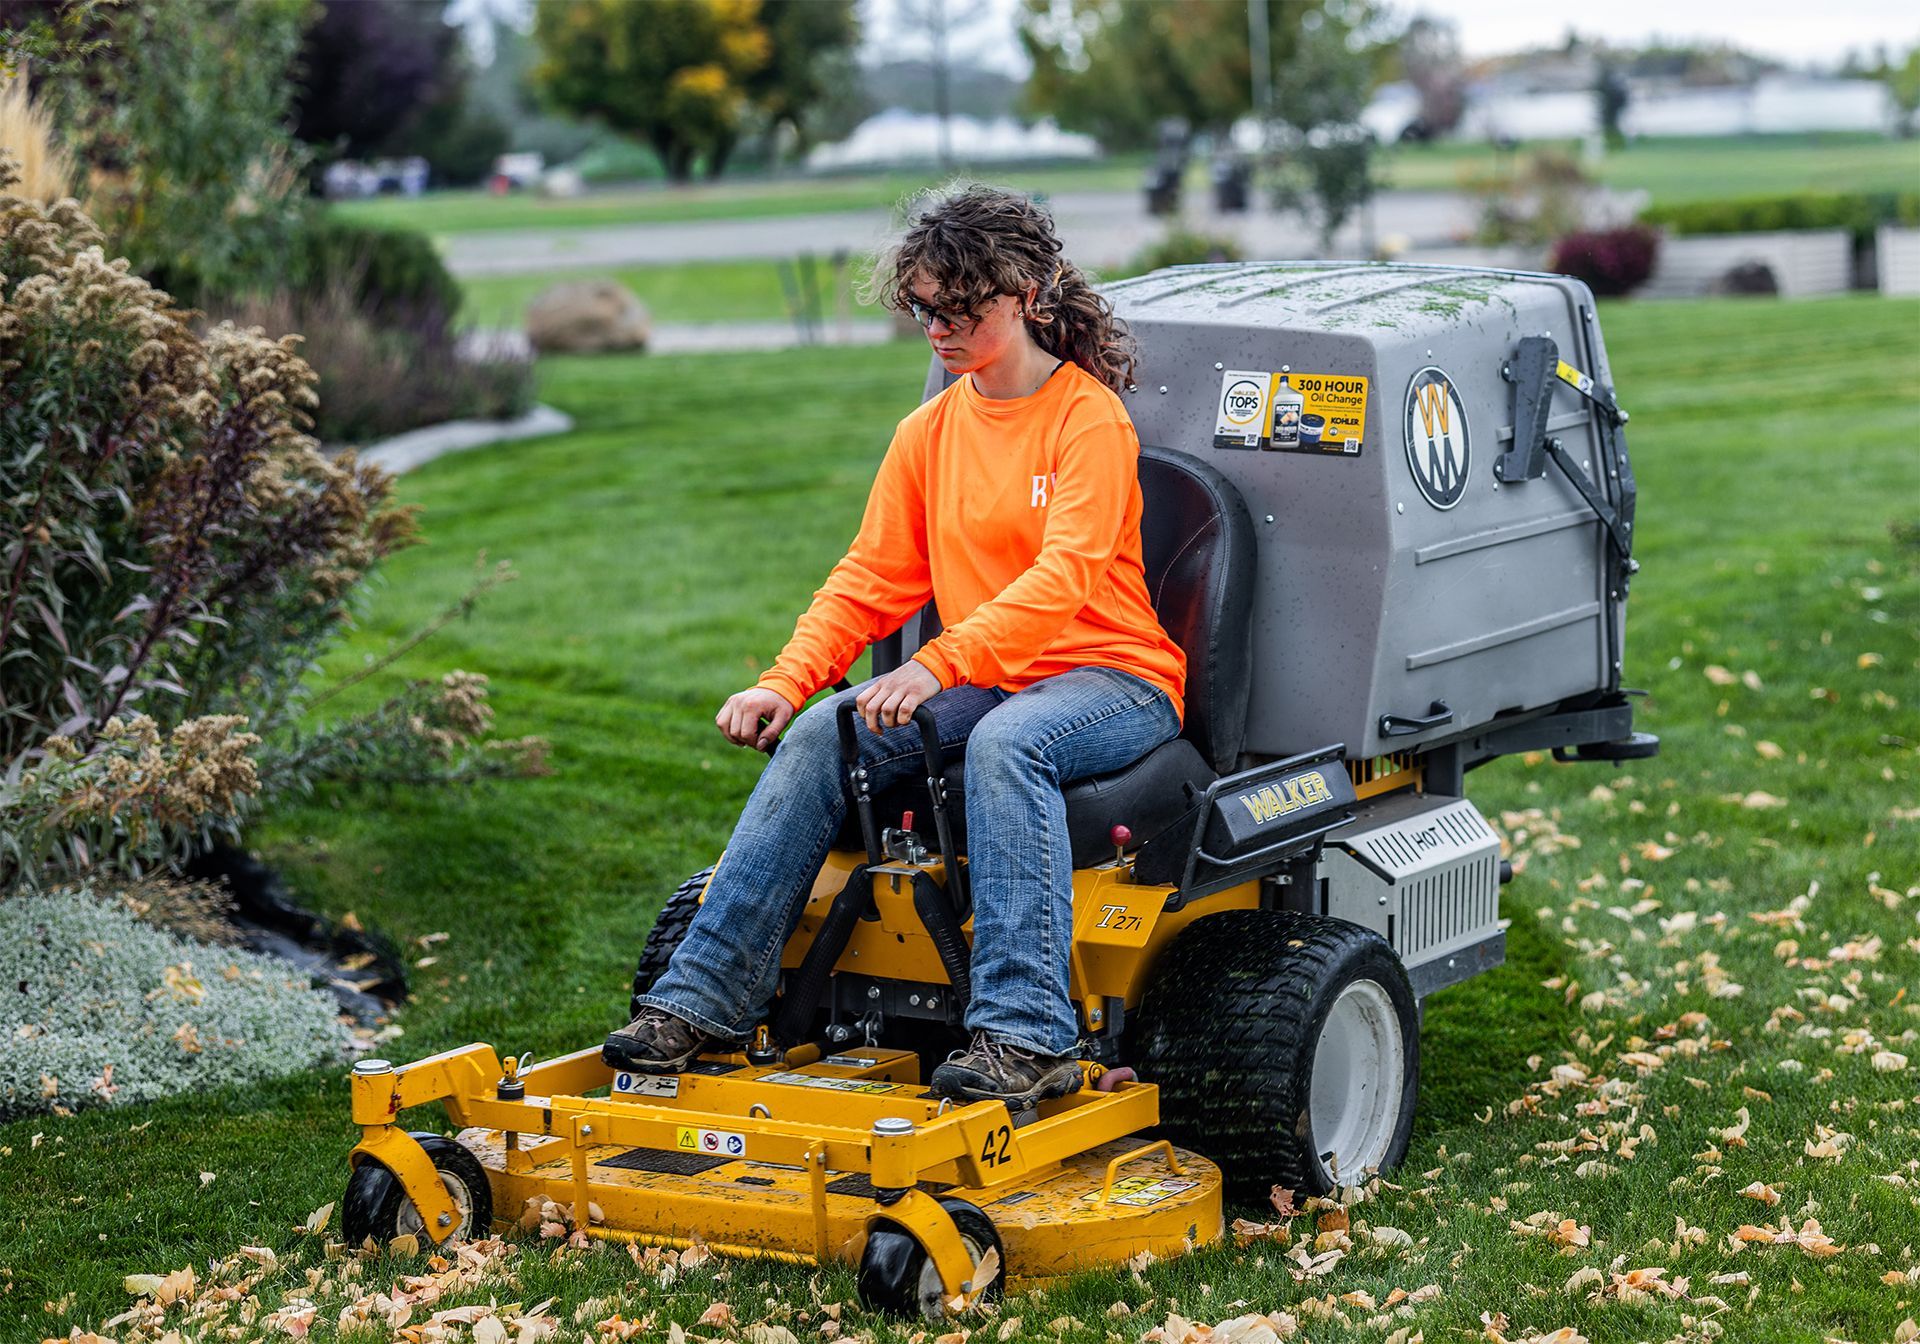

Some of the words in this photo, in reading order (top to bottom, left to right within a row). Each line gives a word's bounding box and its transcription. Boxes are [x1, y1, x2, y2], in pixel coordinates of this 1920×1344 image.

[1298, 379, 1322, 391] 300
[1324, 381, 1364, 394] HOUR
[1229, 396, 1259, 409] TOPS
[1310, 393, 1324, 402] Oil
[1326, 394, 1363, 406] Change
[1330, 416, 1360, 426] KOHLER
[1239, 771, 1334, 825] WALKER
[1410, 826, 1444, 852] HOT
[980, 1124, 1012, 1169] 42
